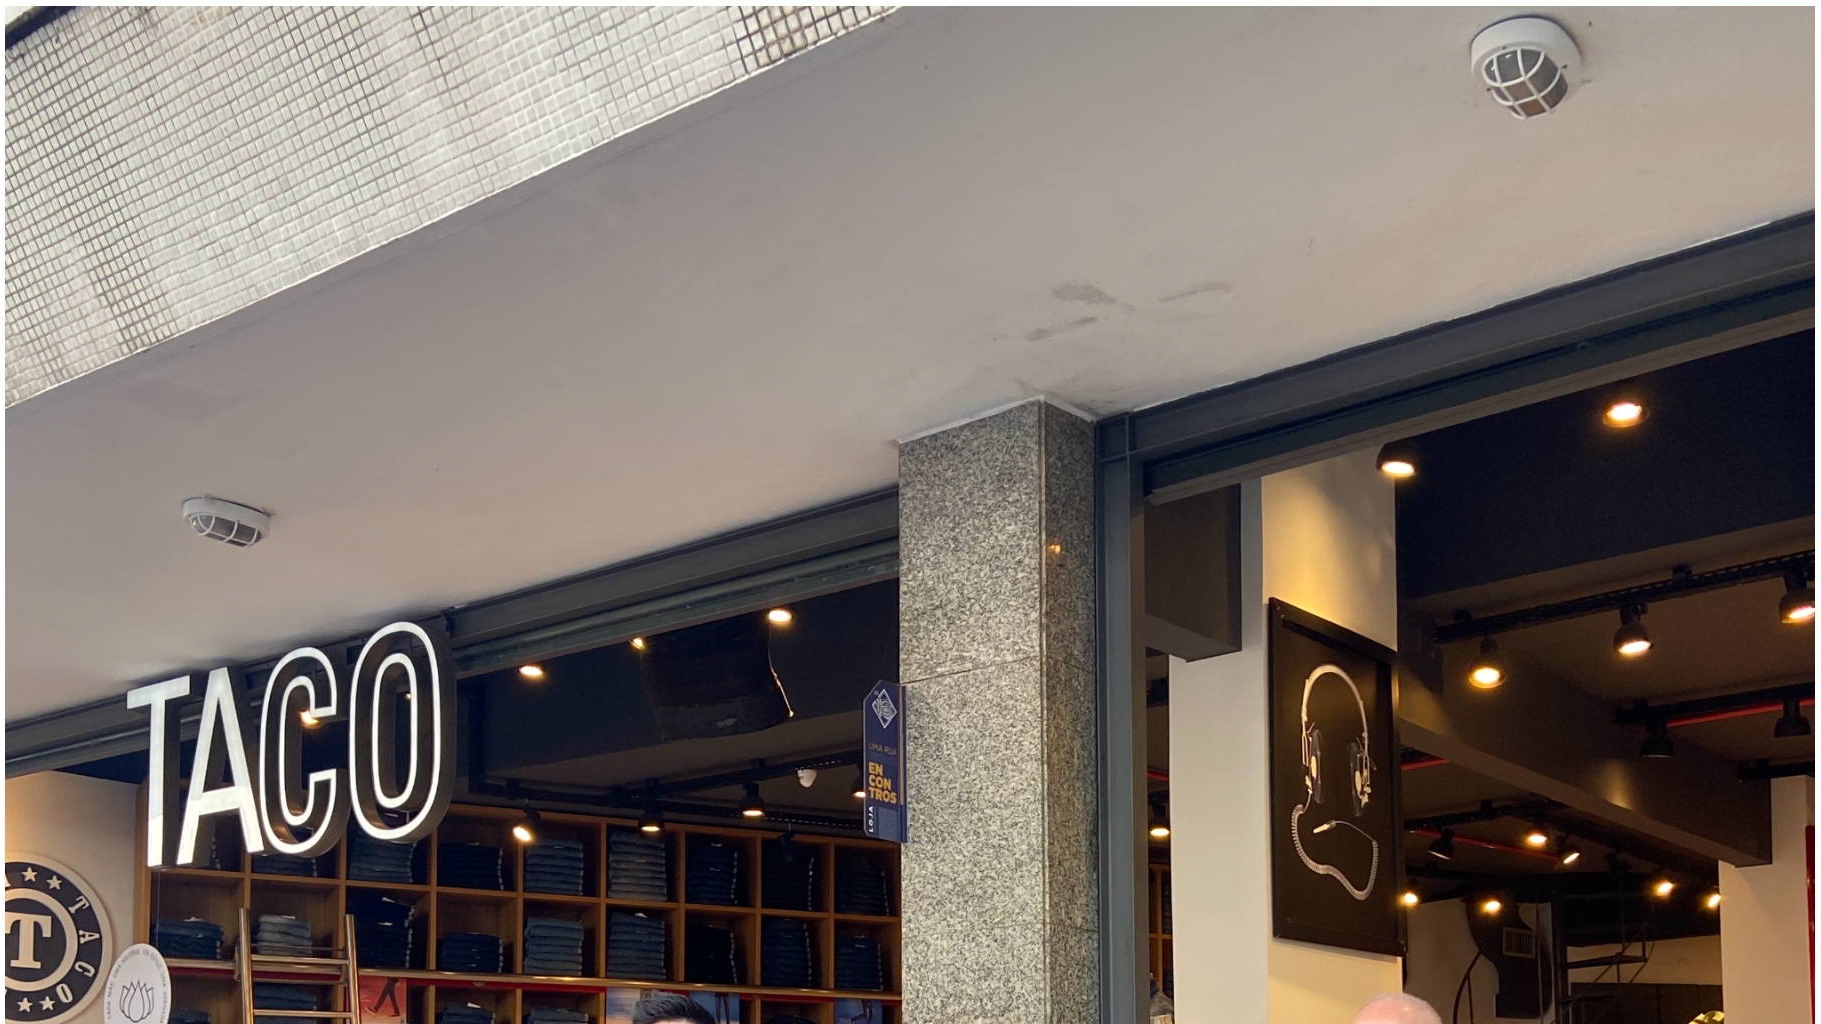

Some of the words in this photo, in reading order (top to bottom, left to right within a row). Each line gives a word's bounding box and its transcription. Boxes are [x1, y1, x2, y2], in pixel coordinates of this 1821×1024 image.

[126, 620, 450, 869] TACO
[868, 762, 883, 776] EN
[868, 775, 892, 791] CON
[868, 787, 897, 804] TROS
[56, 895, 100, 1004] TACO
